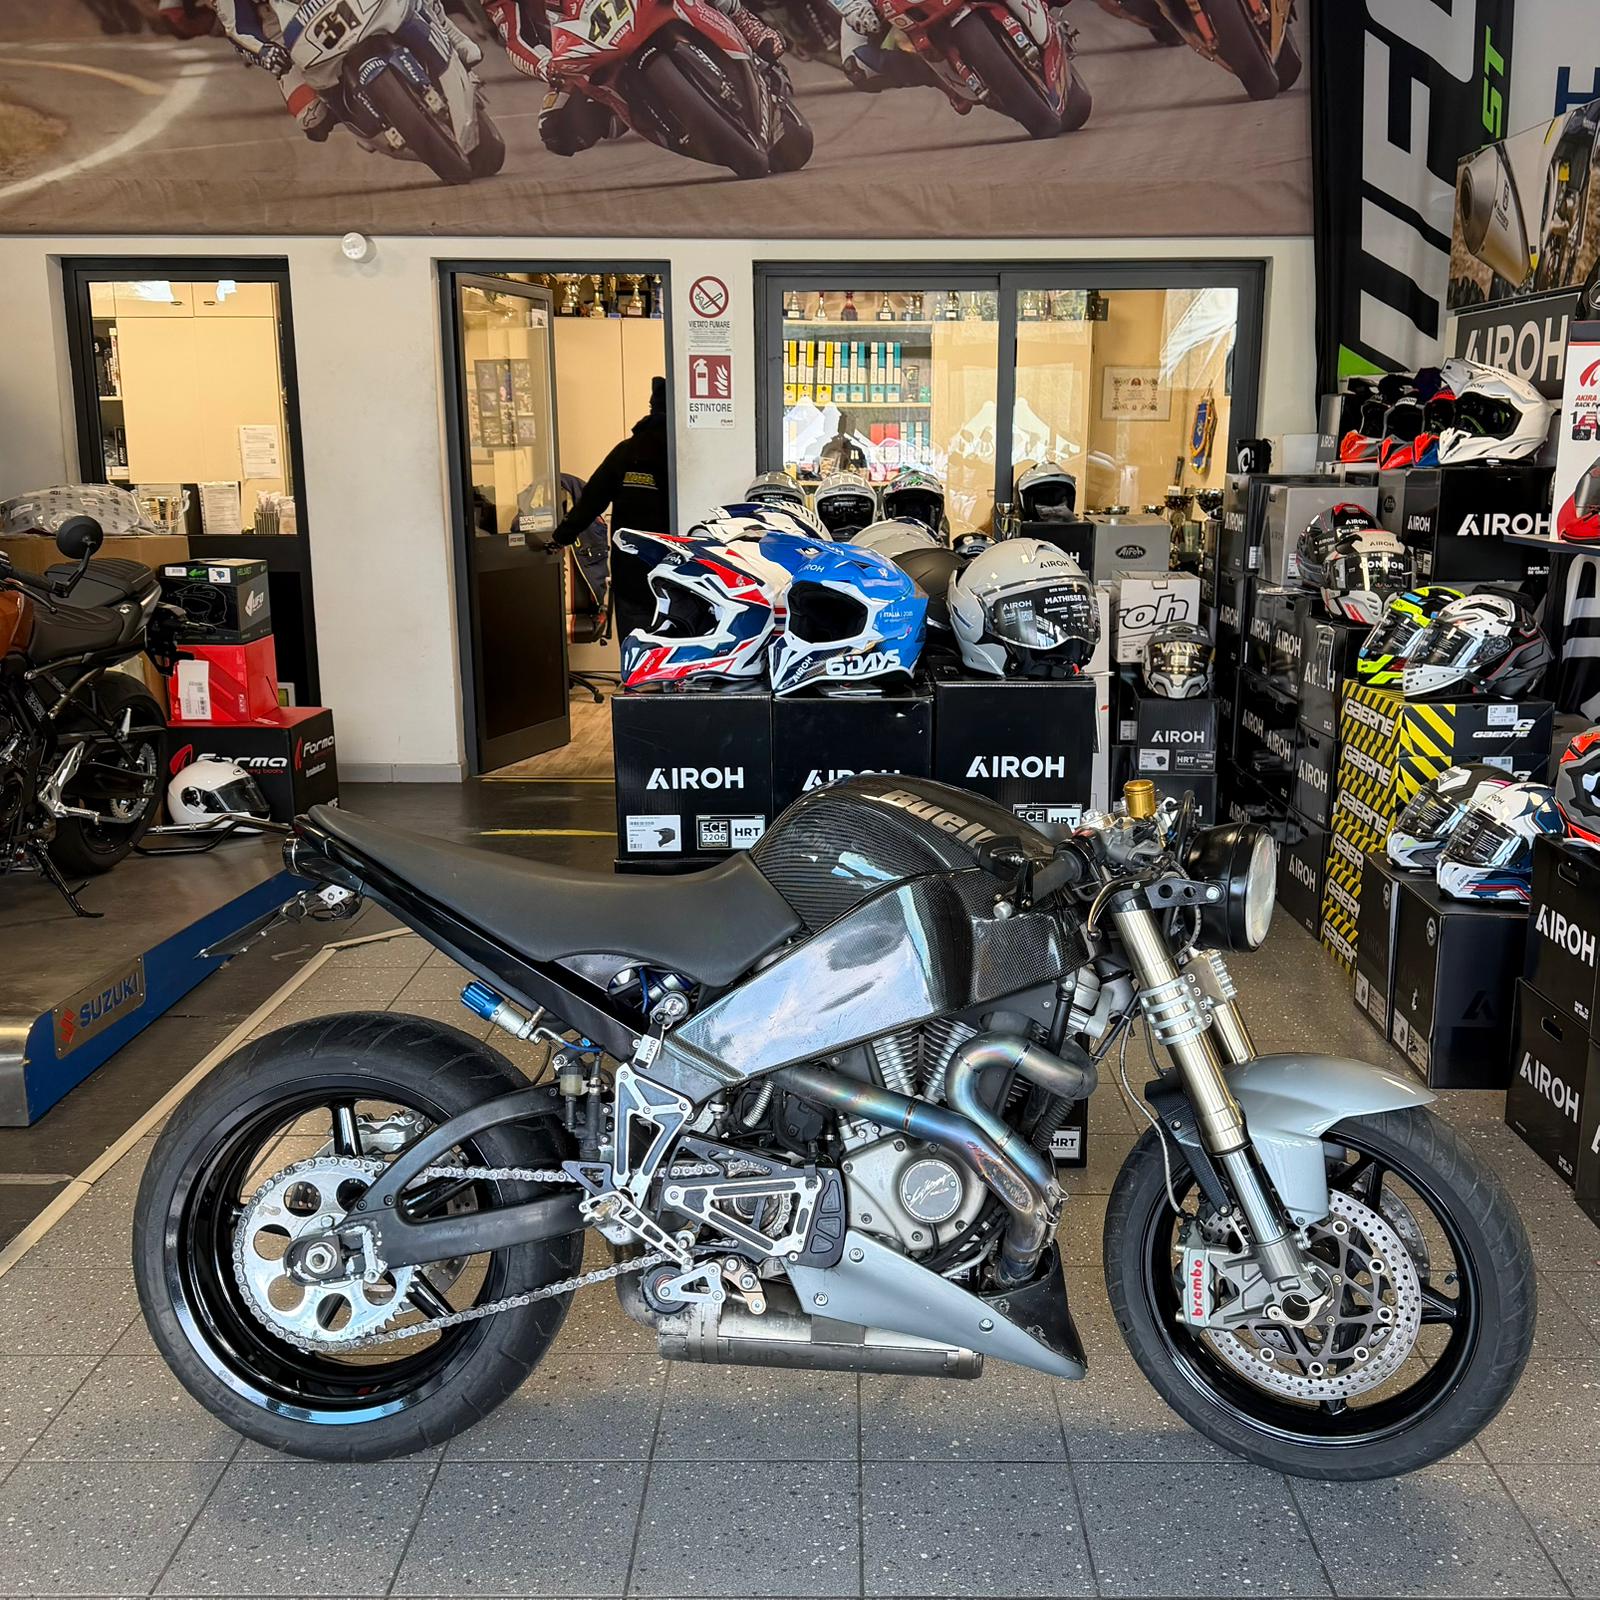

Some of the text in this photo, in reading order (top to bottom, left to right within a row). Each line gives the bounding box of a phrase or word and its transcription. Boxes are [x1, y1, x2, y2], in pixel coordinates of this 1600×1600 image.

[1481, 25, 1504, 139] ST
[688, 321, 730, 329] VIETATO FUMARE
[1465, 314, 1569, 382] AIROH
[689, 403, 732, 412] ESTINTORE
[1575, 394, 1598, 402] AKIRA
[1225, 512, 1244, 533] AIROH
[1408, 515, 1430, 534] AIROH
[1457, 513, 1551, 536] AIROH
[1040, 560, 1070, 568] AIROH
[1003, 600, 1032, 610] AIROH
[1044, 595, 1082, 605] MATHISSE
[1220, 604, 1239, 628] AIROH
[1250, 616, 1271, 643] AIROH
[1275, 629, 1301, 658] AIROH
[792, 655, 814, 683] AIROH
[825, 649, 901, 676] 6DAYS
[1242, 708, 1264, 738] AIROH
[303, 735, 334, 758] Forma
[1151, 730, 1205, 743] AIROH
[1266, 730, 1291, 762] AIROH
[646, 766, 744, 790] AIROH
[965, 755, 1065, 778] AIROH
[1298, 760, 1328, 794] AIROH
[701, 822, 726, 832] ECE
[734, 827, 761, 837] HRT
[1333, 832, 1363, 871] GAER
[1289, 854, 1316, 893] AIROH
[1327, 876, 1360, 920] GAER
[1535, 903, 1596, 967] AIROH
[78, 972, 139, 1028] SUZUKI
[1519, 1052, 1580, 1124] AIROH
[1050, 1138, 1076, 1147] HRT
[1191, 1258, 1204, 1318] brembo
